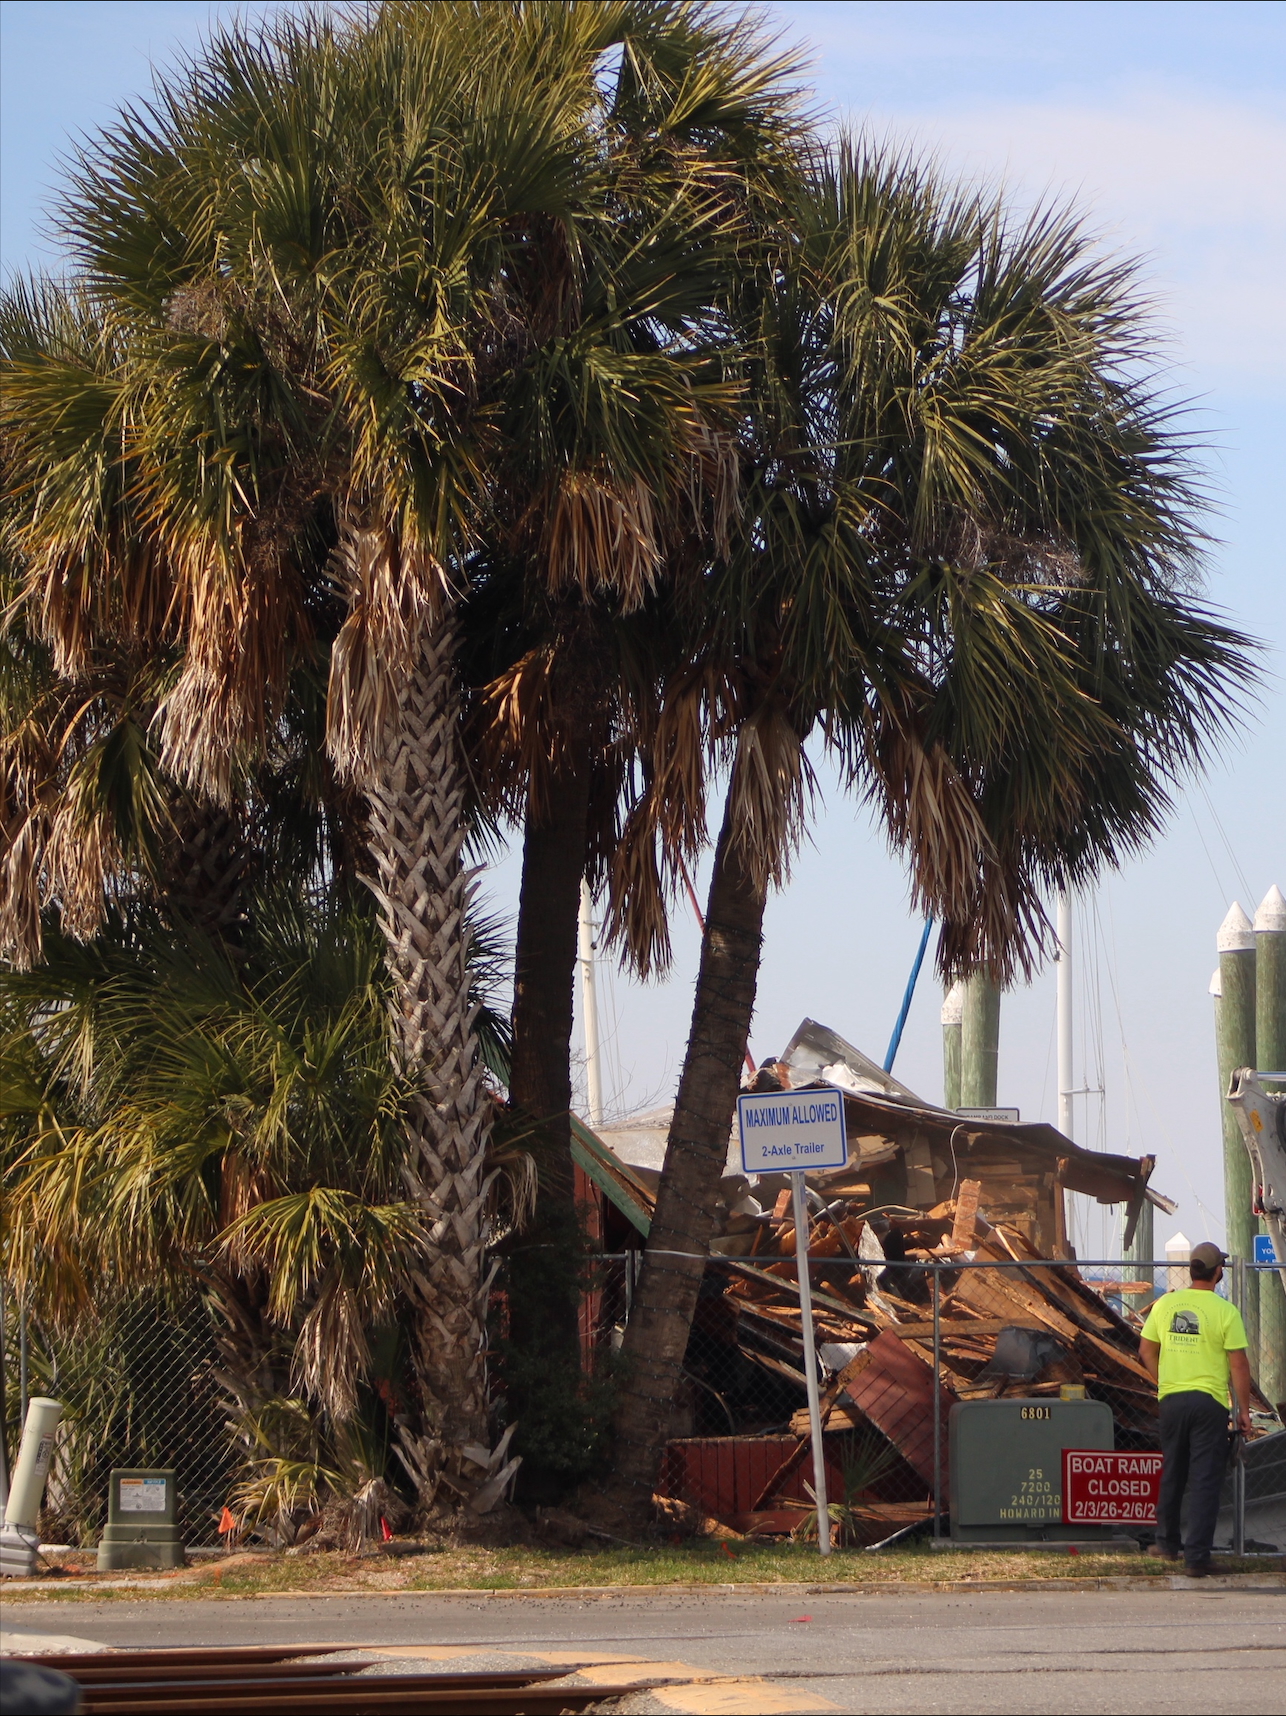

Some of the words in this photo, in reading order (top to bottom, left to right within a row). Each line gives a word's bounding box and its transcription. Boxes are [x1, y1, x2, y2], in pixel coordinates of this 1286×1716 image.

[746, 1106, 790, 1128] MAXIMUM
[792, 1103, 838, 1124] ALLOWED
[762, 1144, 792, 1156] 2-Axle
[794, 1142, 824, 1154] Trailer
[1168, 1334, 1198, 1343] TRIDENT
[1021, 1407, 1050, 1420] 6801
[1072, 1458, 1114, 1474] BOAT
[1118, 1458, 1162, 1475] RAMP
[1029, 1469, 1043, 1479] 25
[1021, 1482, 1050, 1493] 7200
[1088, 1480, 1151, 1496] CLOSED
[1011, 1495, 1061, 1506] 240/120
[1000, 1508, 1045, 1519] HOWARD
[1049, 1508, 1062, 1519] IN
[1075, 1501, 1156, 1518] 2/3/26-2/6/2
